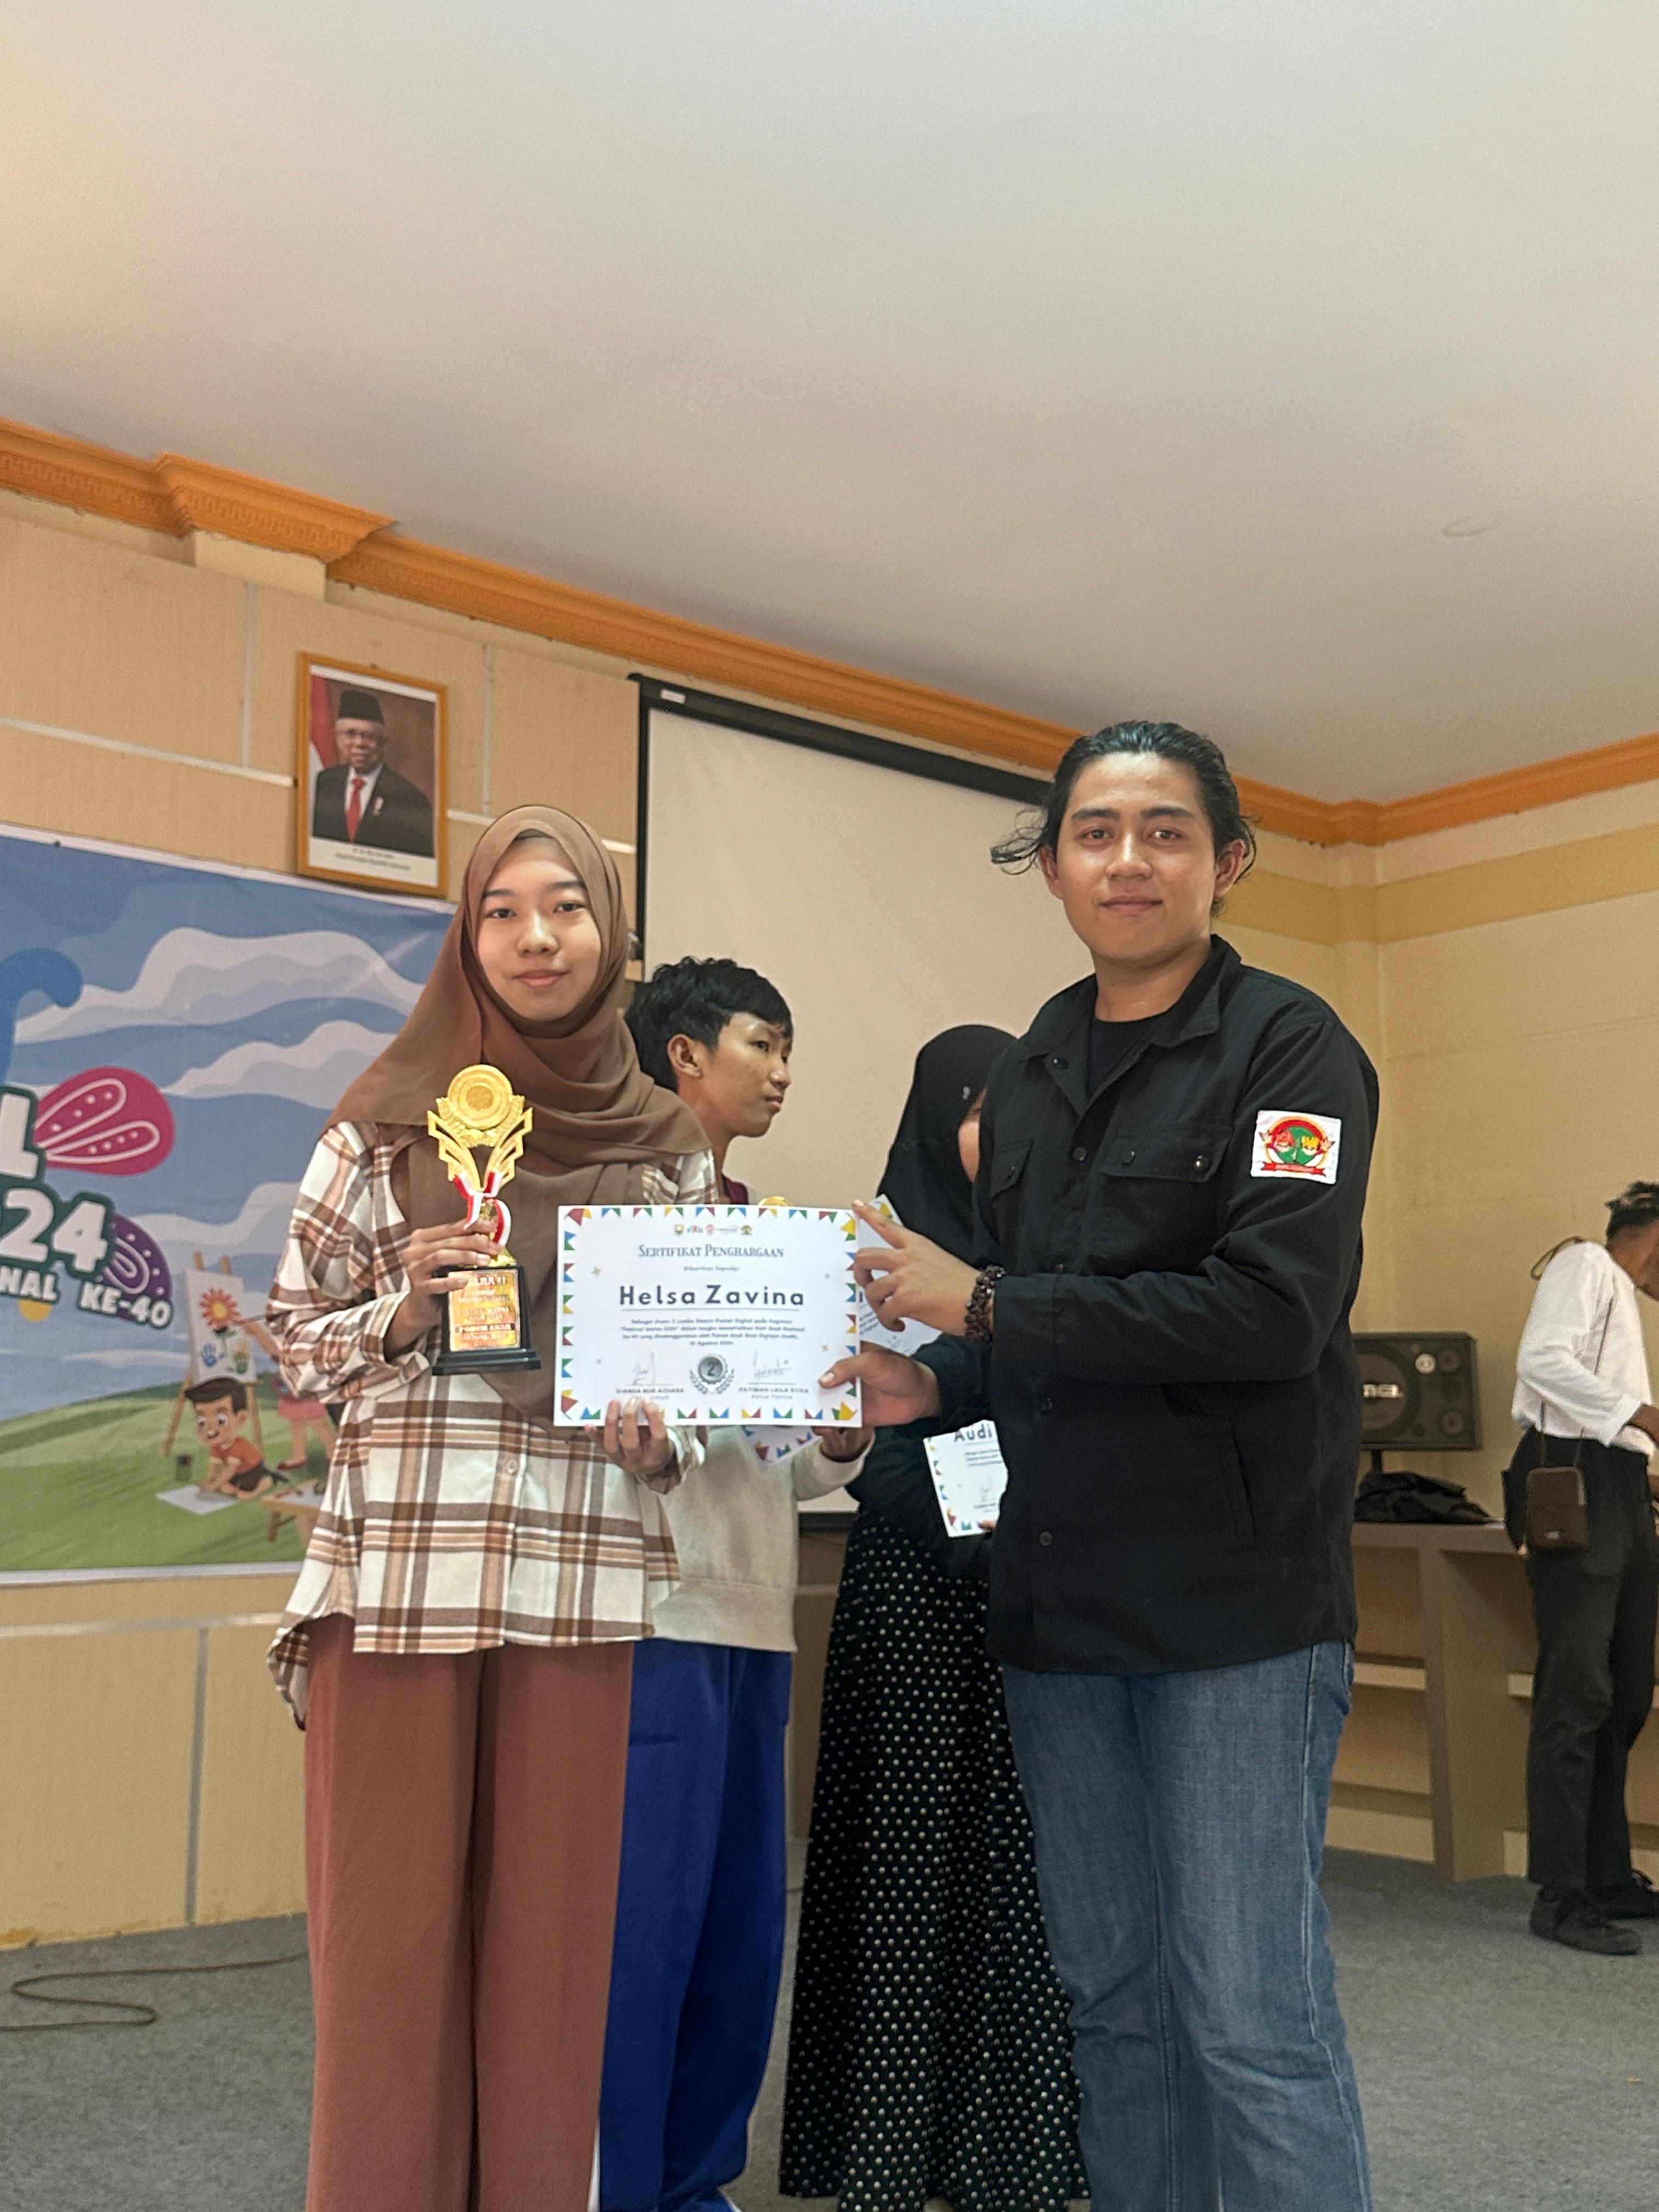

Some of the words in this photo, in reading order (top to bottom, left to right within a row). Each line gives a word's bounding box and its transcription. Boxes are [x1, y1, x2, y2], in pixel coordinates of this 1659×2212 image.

[704, 1244, 784, 1257] PENGHARGAAN
[619, 1285, 696, 1305] Helsa
[706, 1284, 804, 1305] Zavina
[80, 1282, 171, 1328] KE-40
[707, 1360, 715, 1376] 2
[953, 1423, 992, 1442] Audi
